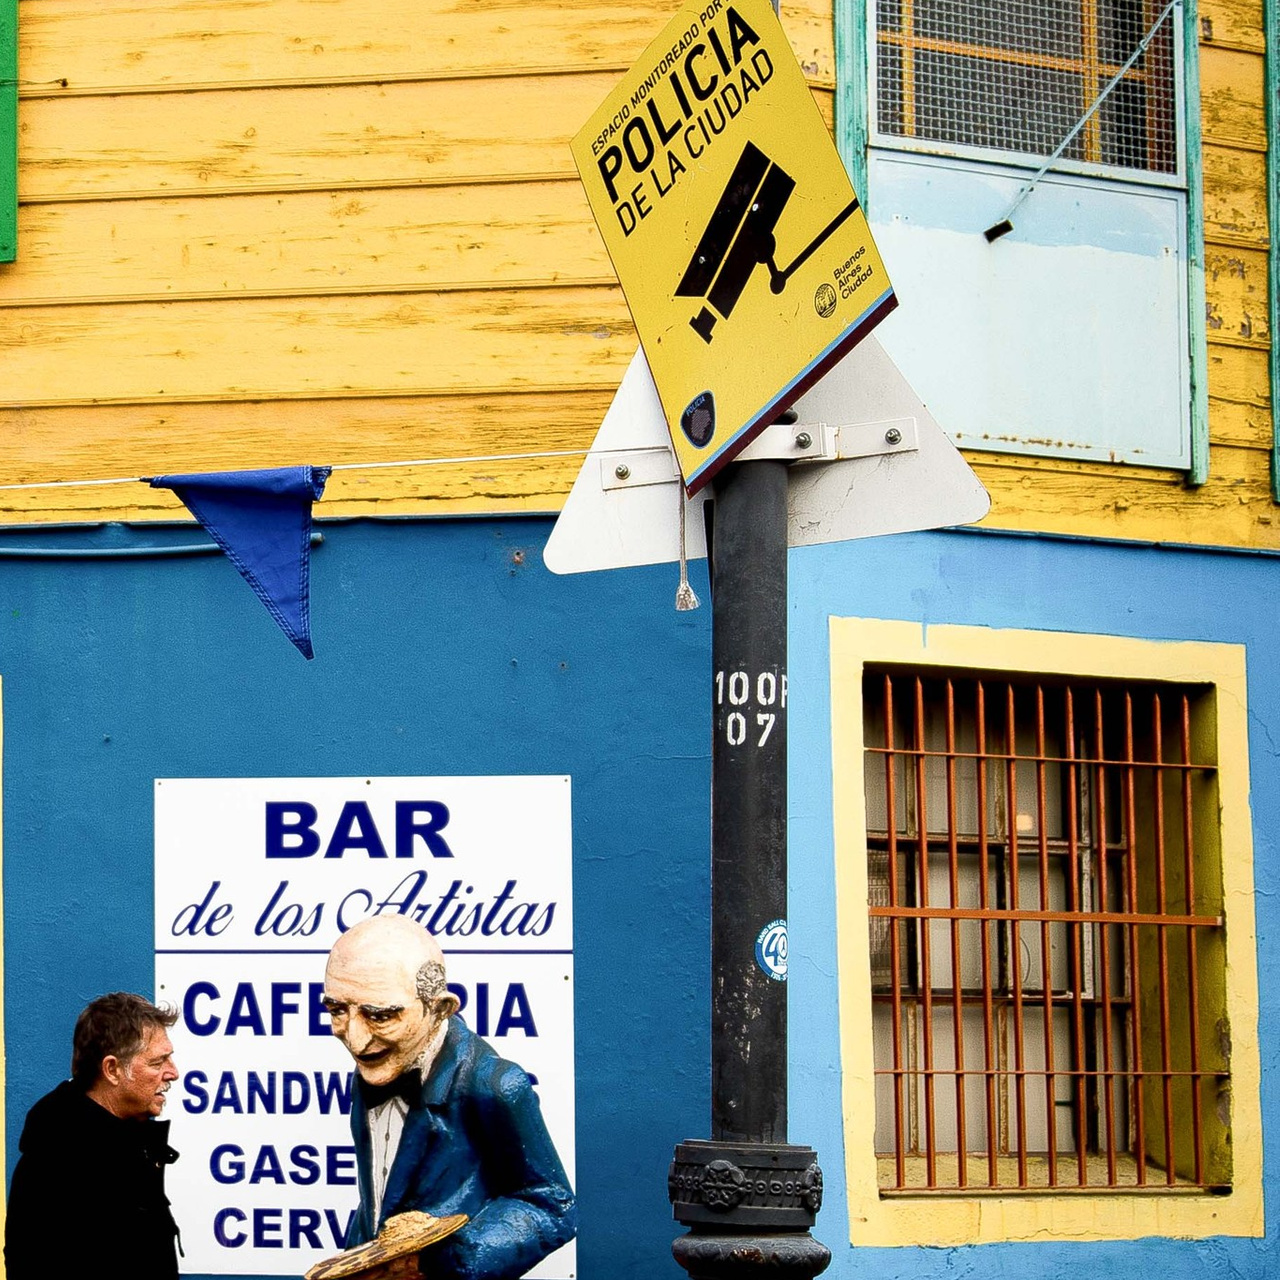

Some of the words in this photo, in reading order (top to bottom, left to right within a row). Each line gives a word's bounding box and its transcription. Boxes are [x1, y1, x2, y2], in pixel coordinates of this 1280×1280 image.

[591, 104, 631, 157] ESPACIO
[630, 23, 700, 109] MONITOREADO
[597, 6, 761, 205] POLICIA
[615, 181, 653, 238] DE
[650, 149, 687, 198] LA
[683, 48, 774, 159] CIUDAD
[833, 245, 866, 280] Buenos
[838, 263, 862, 291] Aires
[841, 264, 873, 300] Ciudad
[726, 712, 776, 747] 07
[264, 800, 455, 859] BAR
[171, 880, 235, 937] de
[253, 879, 326, 937] los
[336, 869, 557, 937] Artistas
